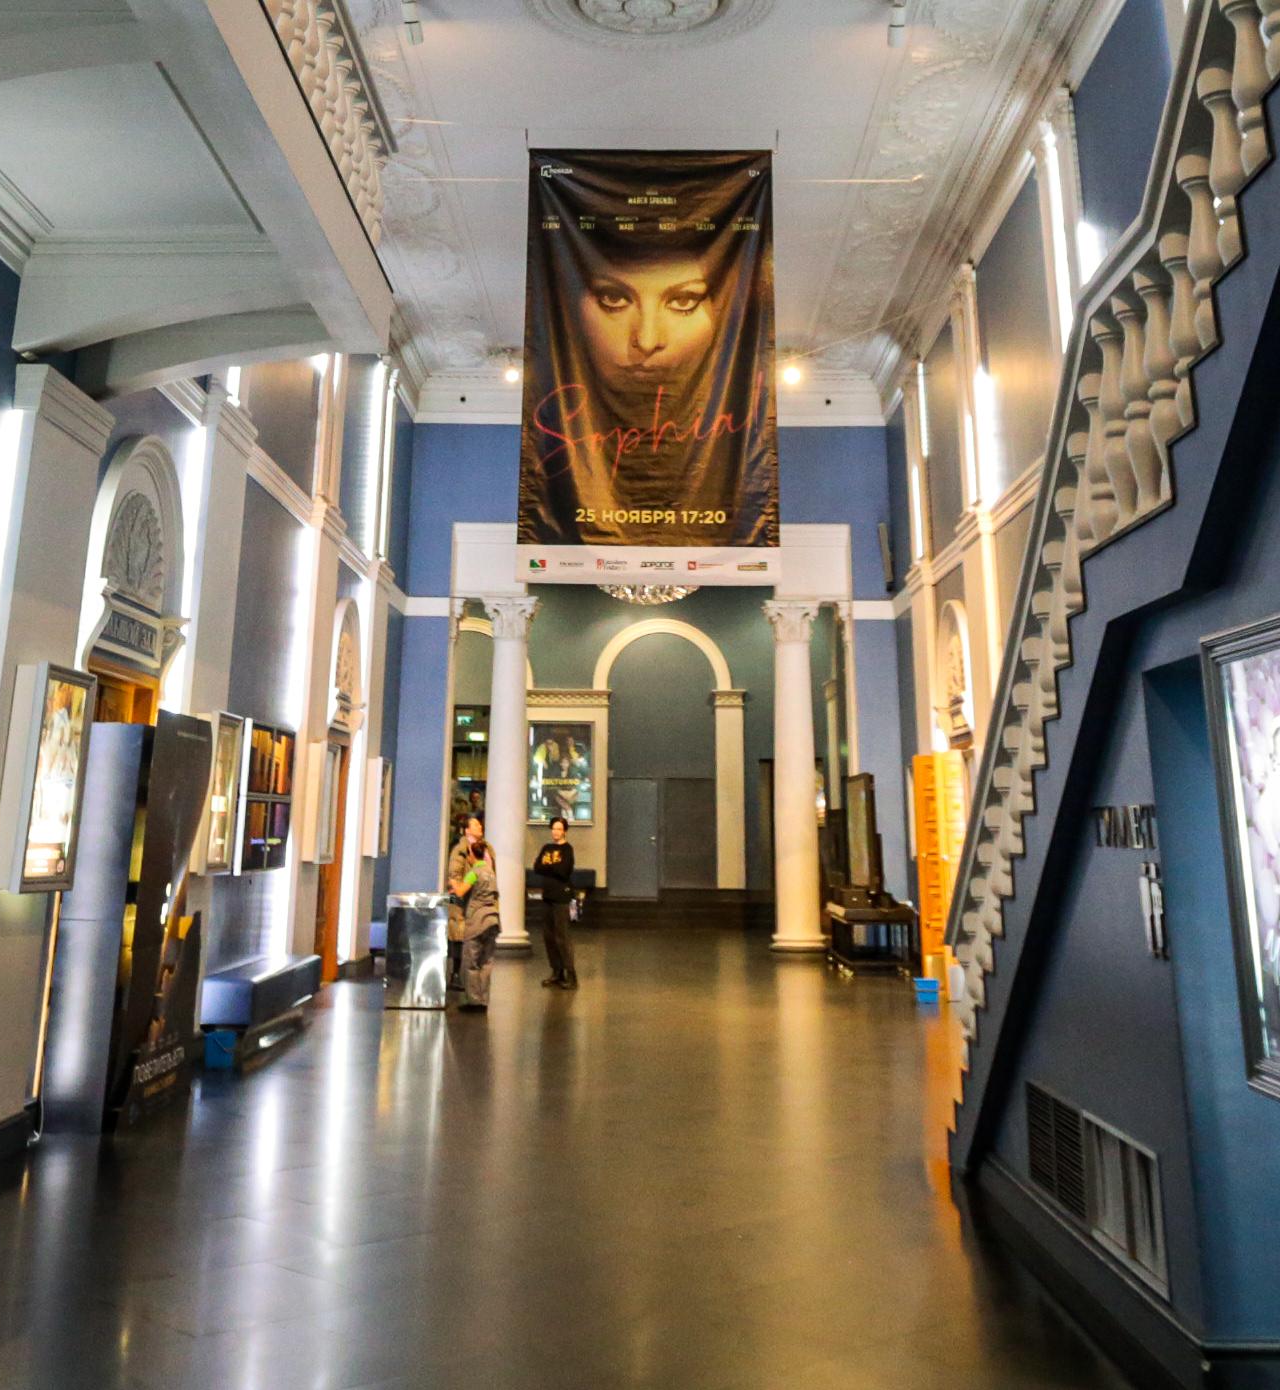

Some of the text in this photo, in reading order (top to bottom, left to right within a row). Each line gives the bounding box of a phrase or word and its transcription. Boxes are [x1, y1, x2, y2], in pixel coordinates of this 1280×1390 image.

[575, 508, 727, 524] 25 НОЯБРЯ 17:20
